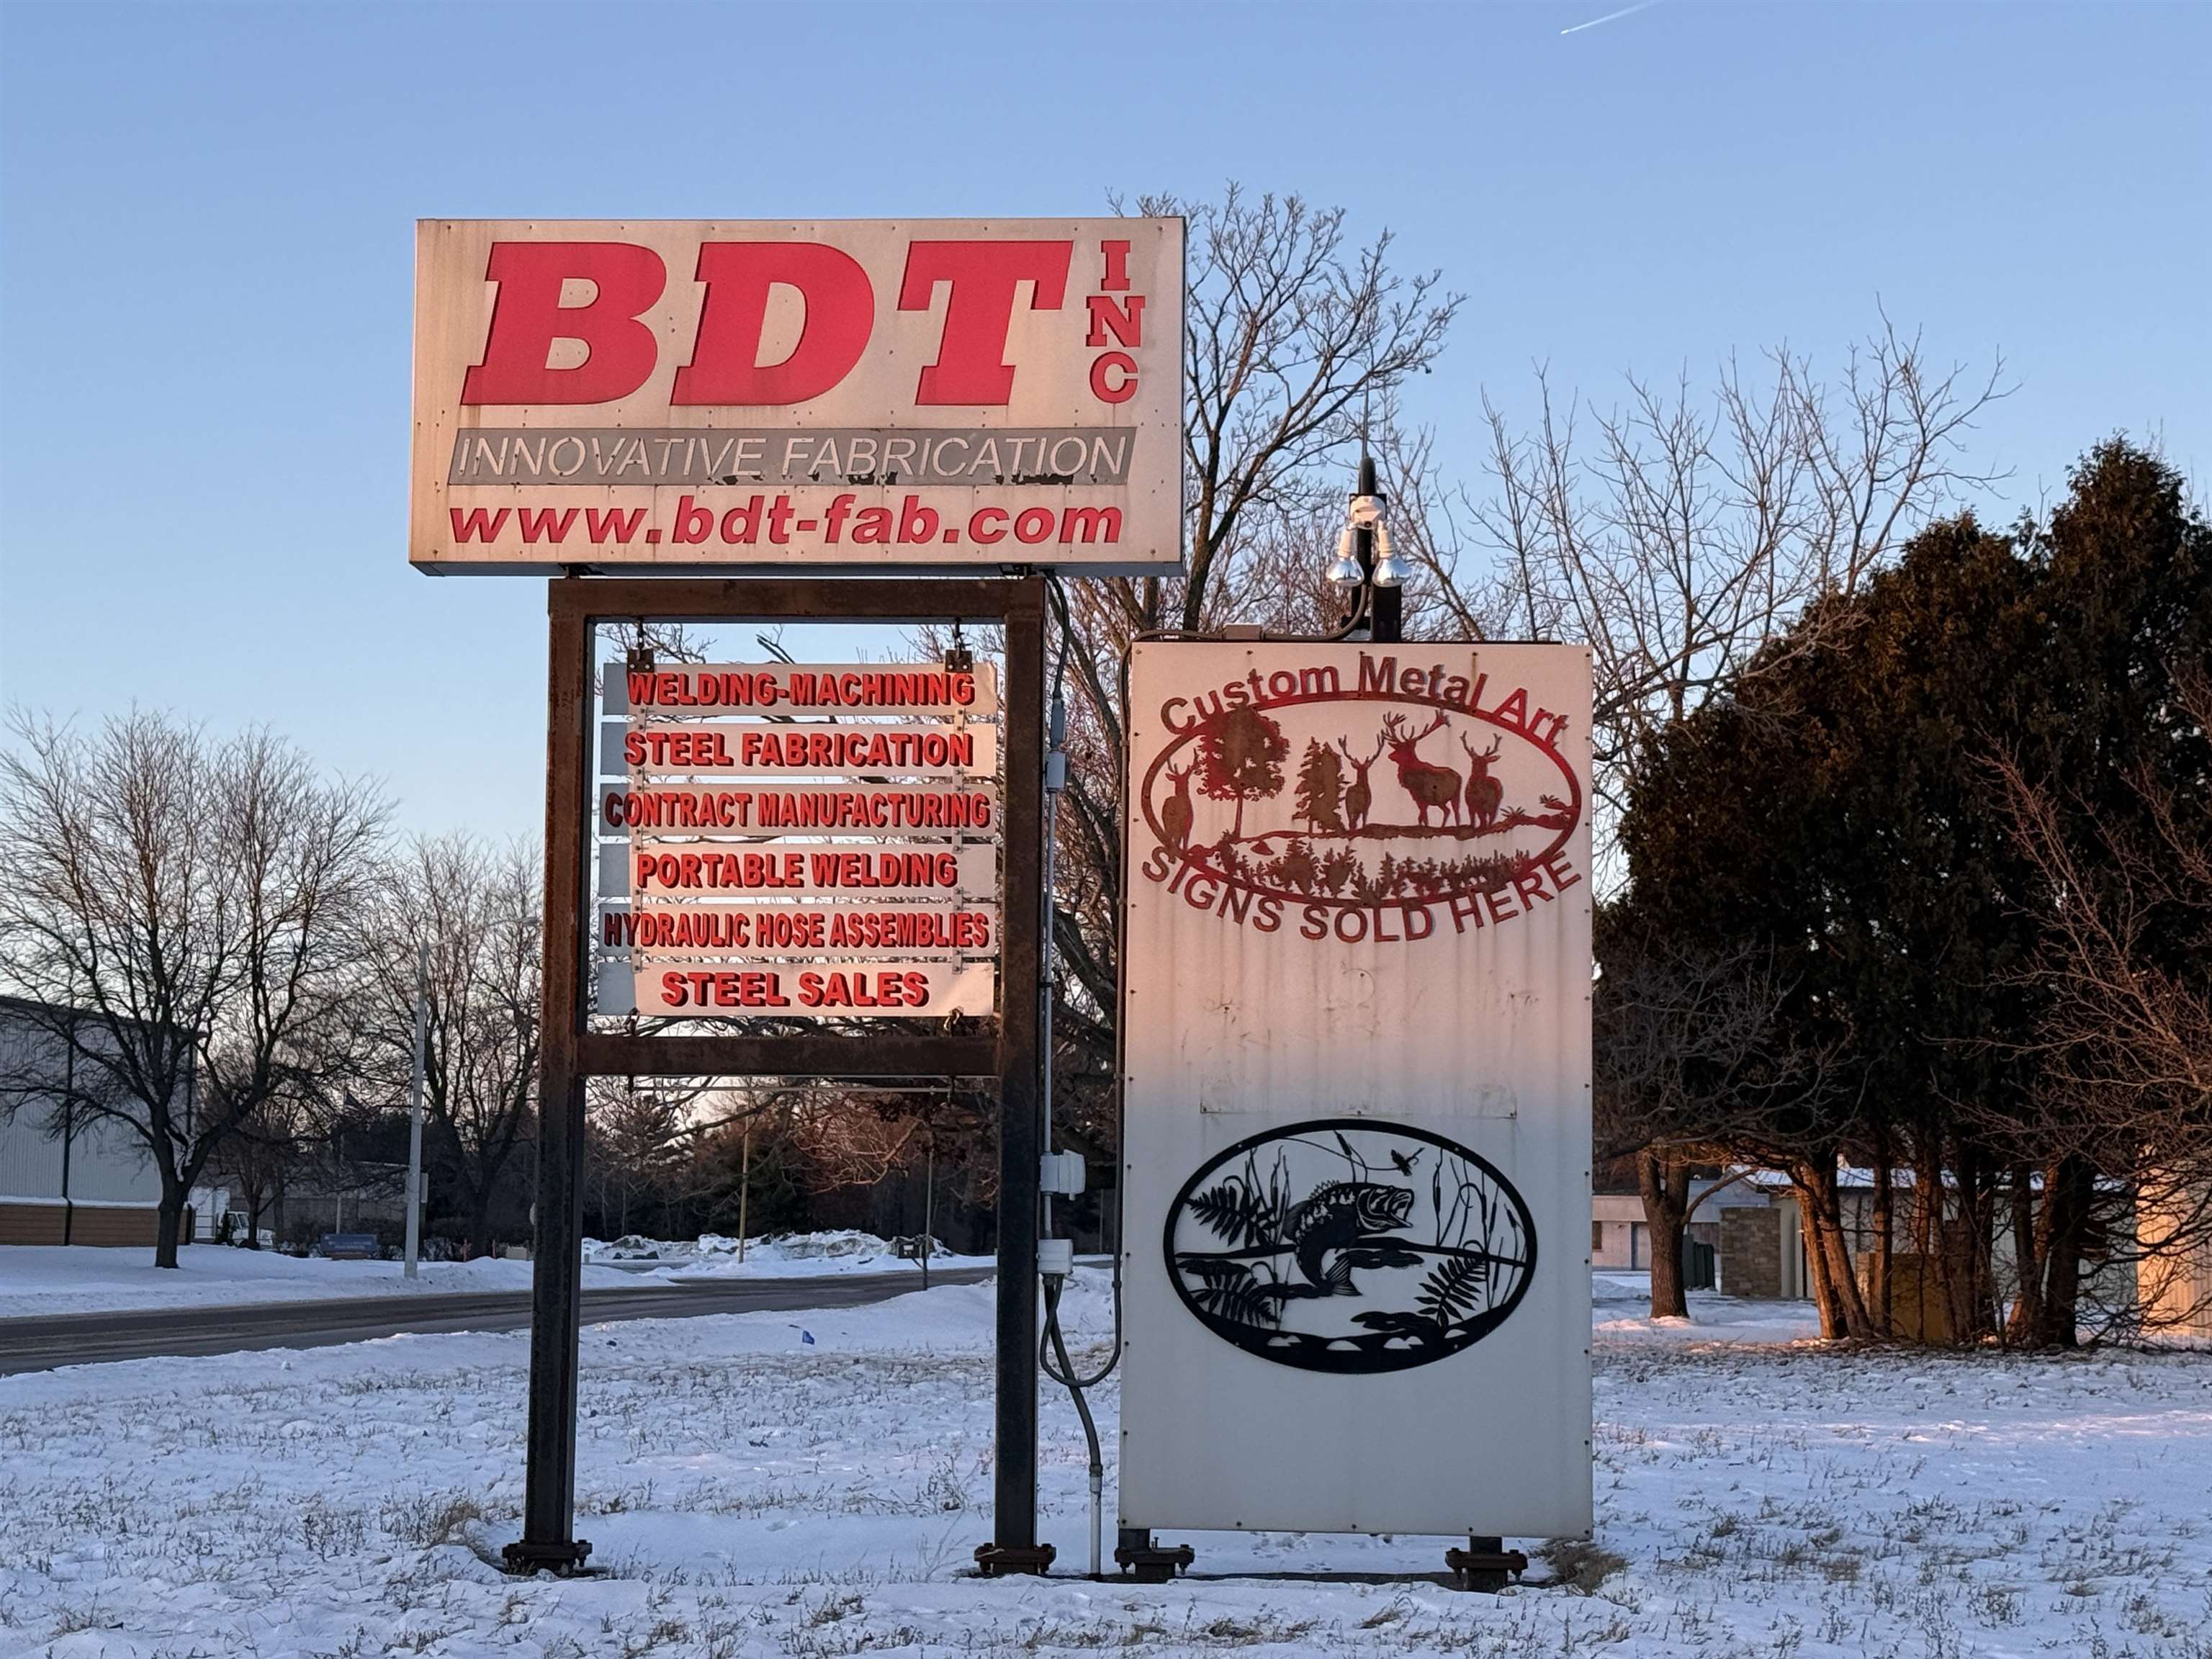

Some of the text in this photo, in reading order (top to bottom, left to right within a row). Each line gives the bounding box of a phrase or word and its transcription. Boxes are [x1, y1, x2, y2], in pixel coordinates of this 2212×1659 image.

[460, 241, 1074, 405] BDT
[1085, 240, 1146, 404] INC
[458, 436, 1126, 478] INNOVATIVE FABRICATION
[449, 494, 1123, 544] www.bdt-fab.com
[628, 673, 976, 706] WELDING-MACHINING
[1160, 655, 1570, 746] Custom Metal Art
[624, 732, 974, 767] STEEL FABRICATION
[605, 792, 991, 828] CONTRACT MANUFACTURING
[637, 853, 958, 888] PORTABLE WELDING
[1141, 845, 1583, 944] SIGNS SOLD HERE
[604, 912, 990, 948] HYDRAULIC HOSE ASSEMBLIES
[662, 971, 930, 1007] STEEL SALES
